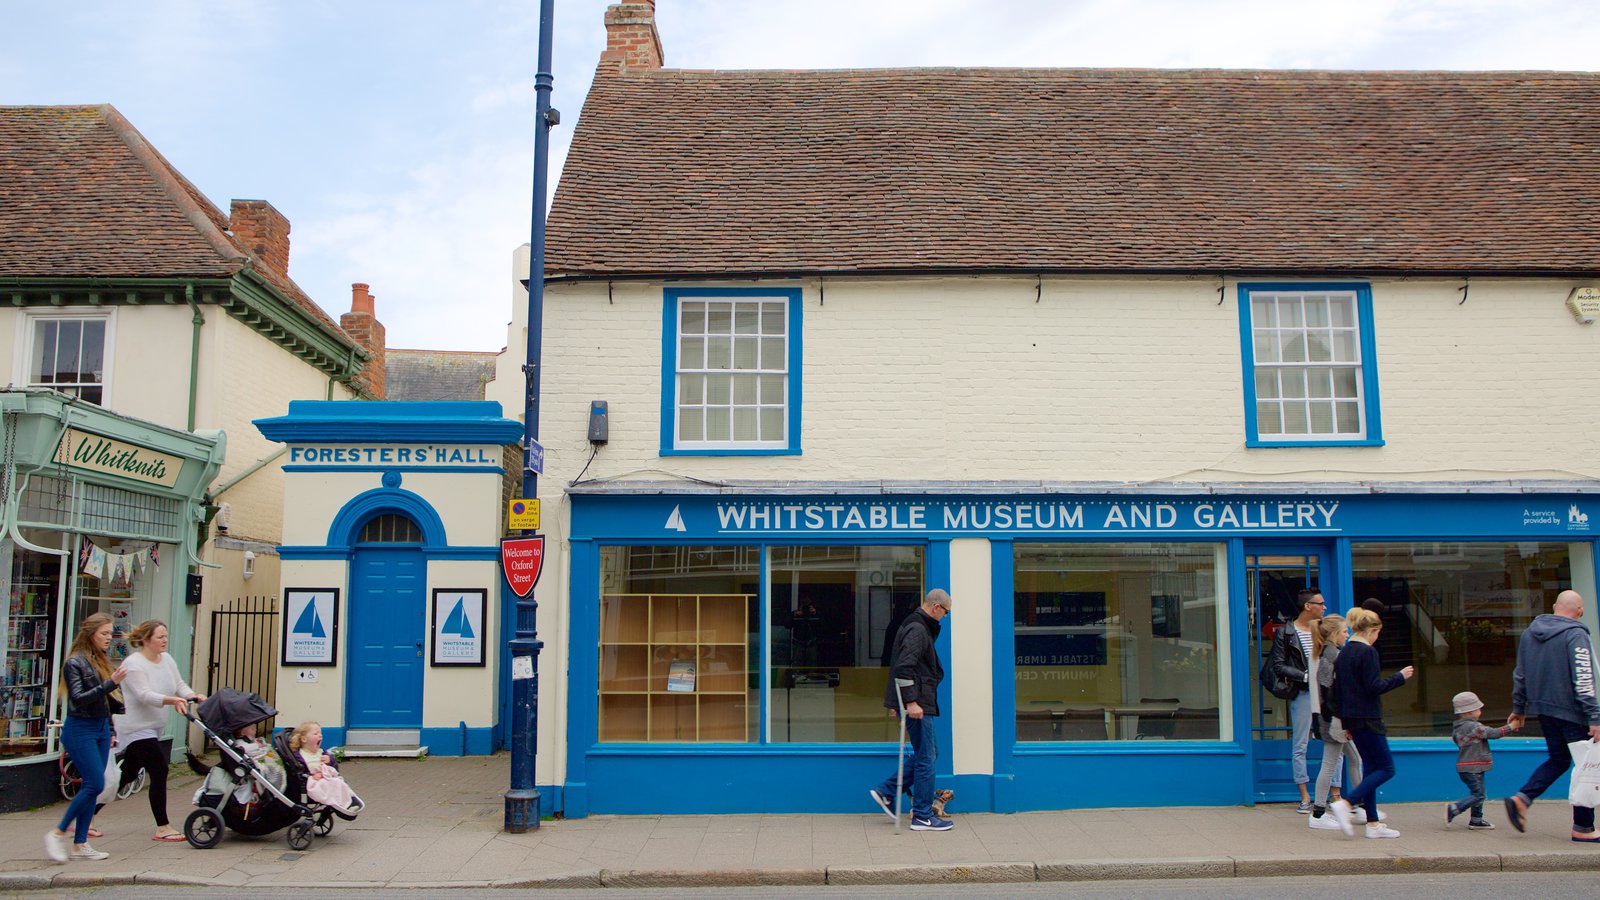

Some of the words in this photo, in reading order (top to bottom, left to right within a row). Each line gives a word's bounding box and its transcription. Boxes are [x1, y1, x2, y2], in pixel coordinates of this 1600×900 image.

[73, 437, 166, 478] Whitknits
[435, 448, 495, 463] HALL.
[717, 505, 926, 529] WHITSTABLE
[943, 505, 1084, 529] MUSEUM
[1103, 504, 1177, 528] AND
[1193, 503, 1340, 528] GALLERY
[1523, 517, 1552, 525] provided
[1553, 516, 1560, 525] by
[505, 548, 532, 557] Welcome
[533, 548, 540, 556] to
[511, 560, 533, 570] Oxford
[513, 573, 531, 583] Street
[1574, 646, 1596, 697] SUPERDRY
